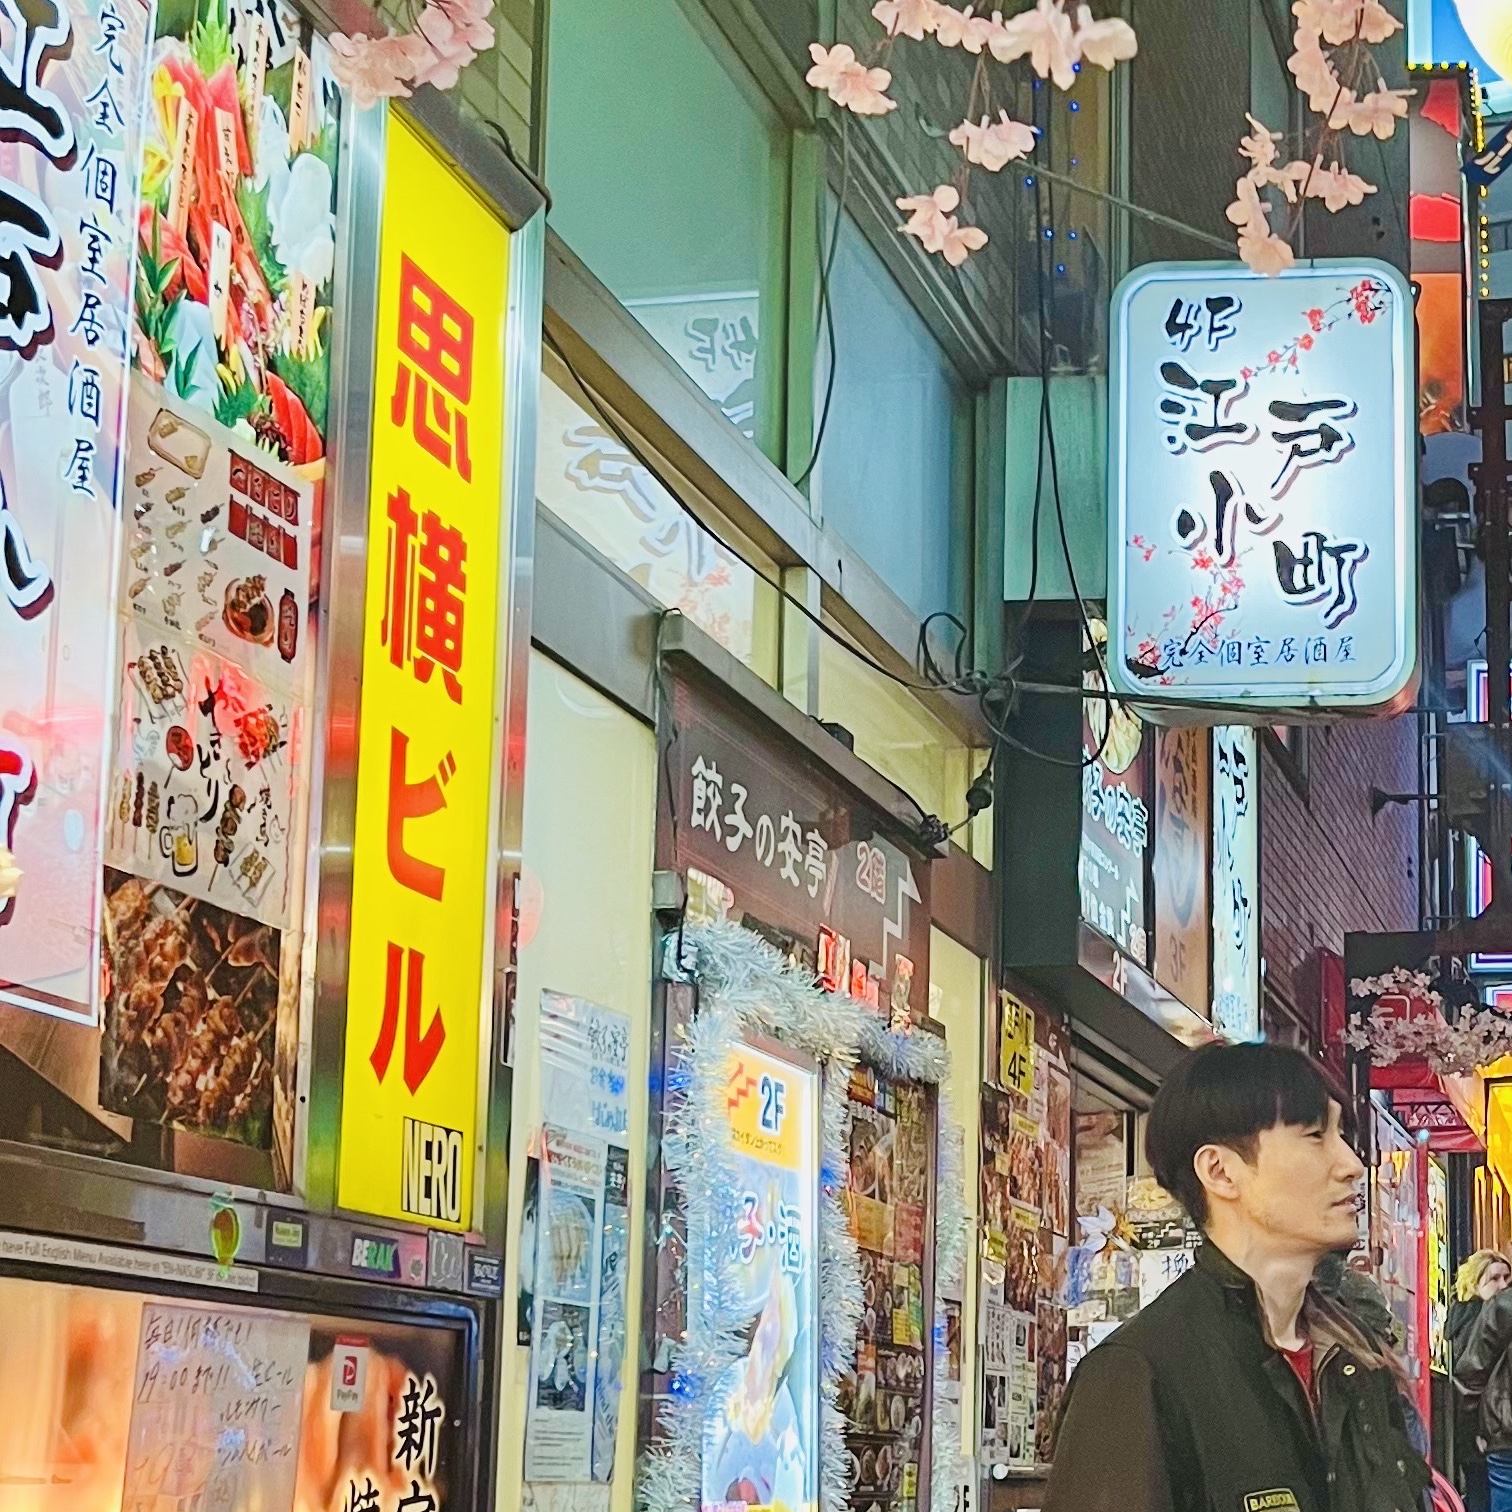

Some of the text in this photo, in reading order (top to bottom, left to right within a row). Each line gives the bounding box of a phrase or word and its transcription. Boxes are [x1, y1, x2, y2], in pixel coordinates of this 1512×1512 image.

[369, 251, 476, 1096] 思横ビル
[1162, 638, 1357, 674] 完全個室居酒屋
[690, 755, 829, 899] 餃子の安亭
[1111, 950, 1129, 996] 2F
[761, 1074, 785, 1132] 2F
[402, 1118, 464, 1222] NERO
[41, 1243, 73, 1262] English
[74, 1248, 96, 1264] Menu
